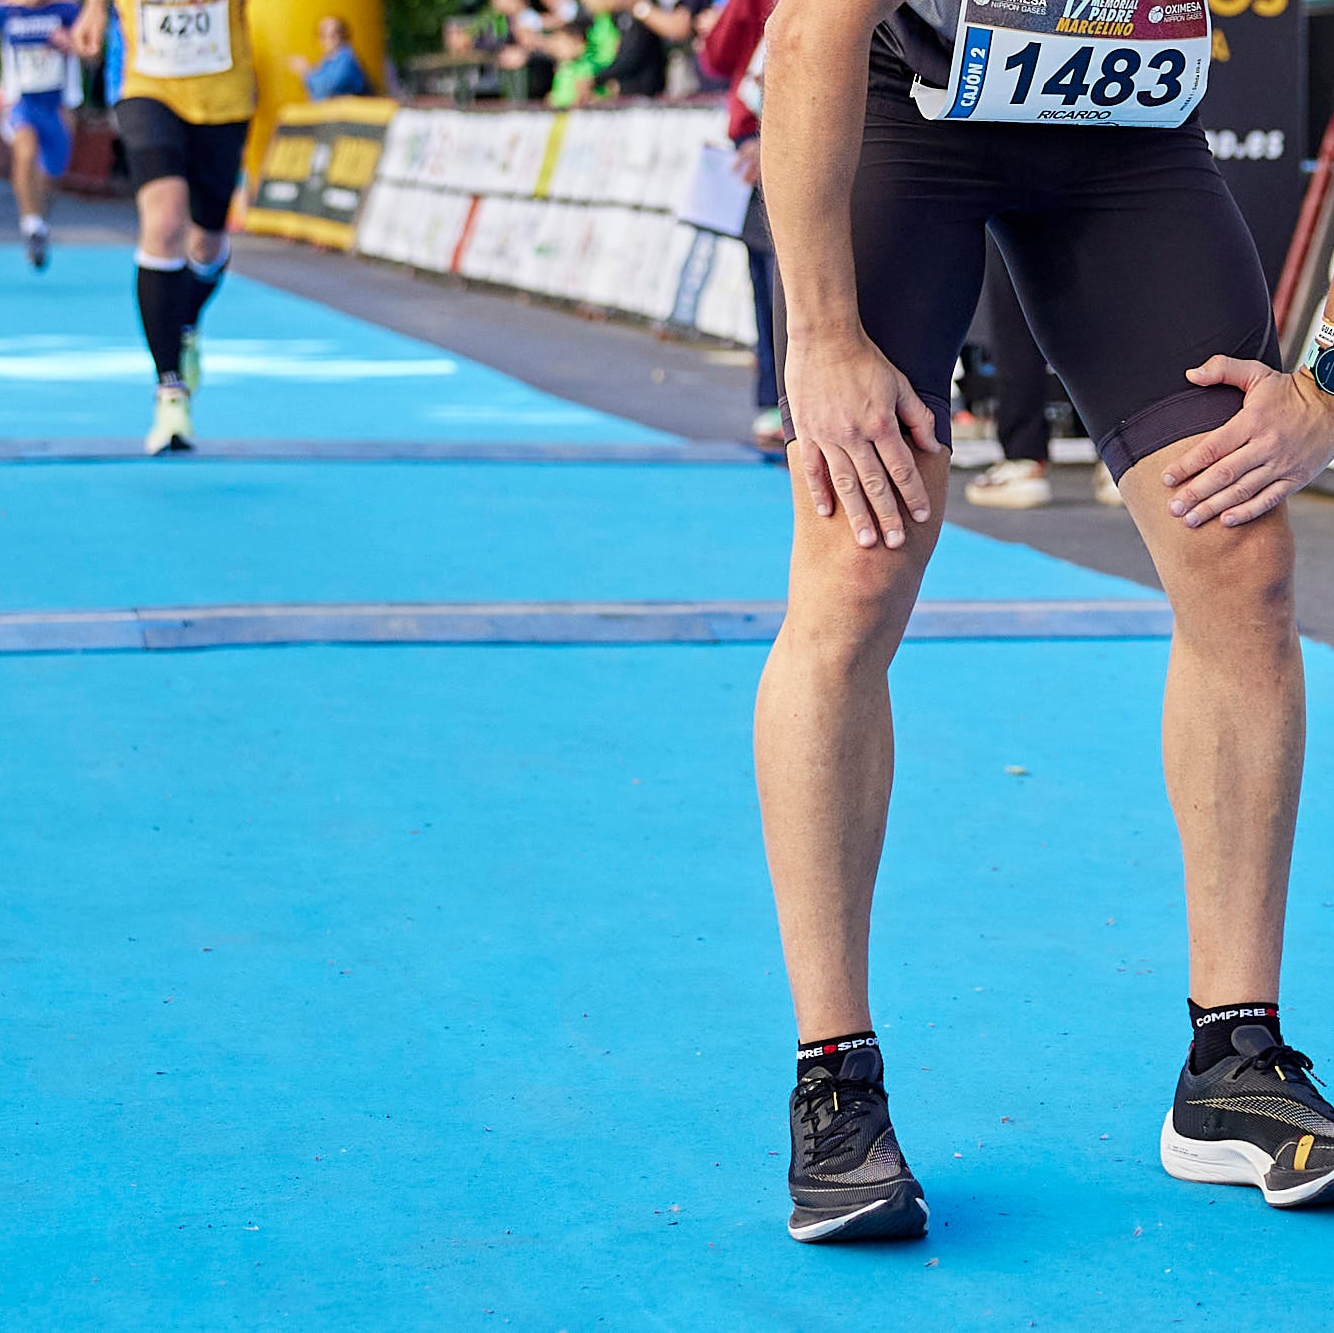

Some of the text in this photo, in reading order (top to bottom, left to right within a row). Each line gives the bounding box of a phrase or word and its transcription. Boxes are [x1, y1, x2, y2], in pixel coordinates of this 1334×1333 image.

[990, 0, 1047, 16] NIPPON GASES
[1088, 7, 1134, 23] PADRE
[1164, 2, 1202, 14] OXIMESA
[159, 11, 211, 37] 420
[1055, 17, 1134, 36] MARCELINO
[1164, 14, 1186, 23] NIPPON
[960, 47, 986, 107] CAJÓN 2
[1005, 41, 1186, 107] 1483
[1037, 109, 1112, 120] RICARDO
